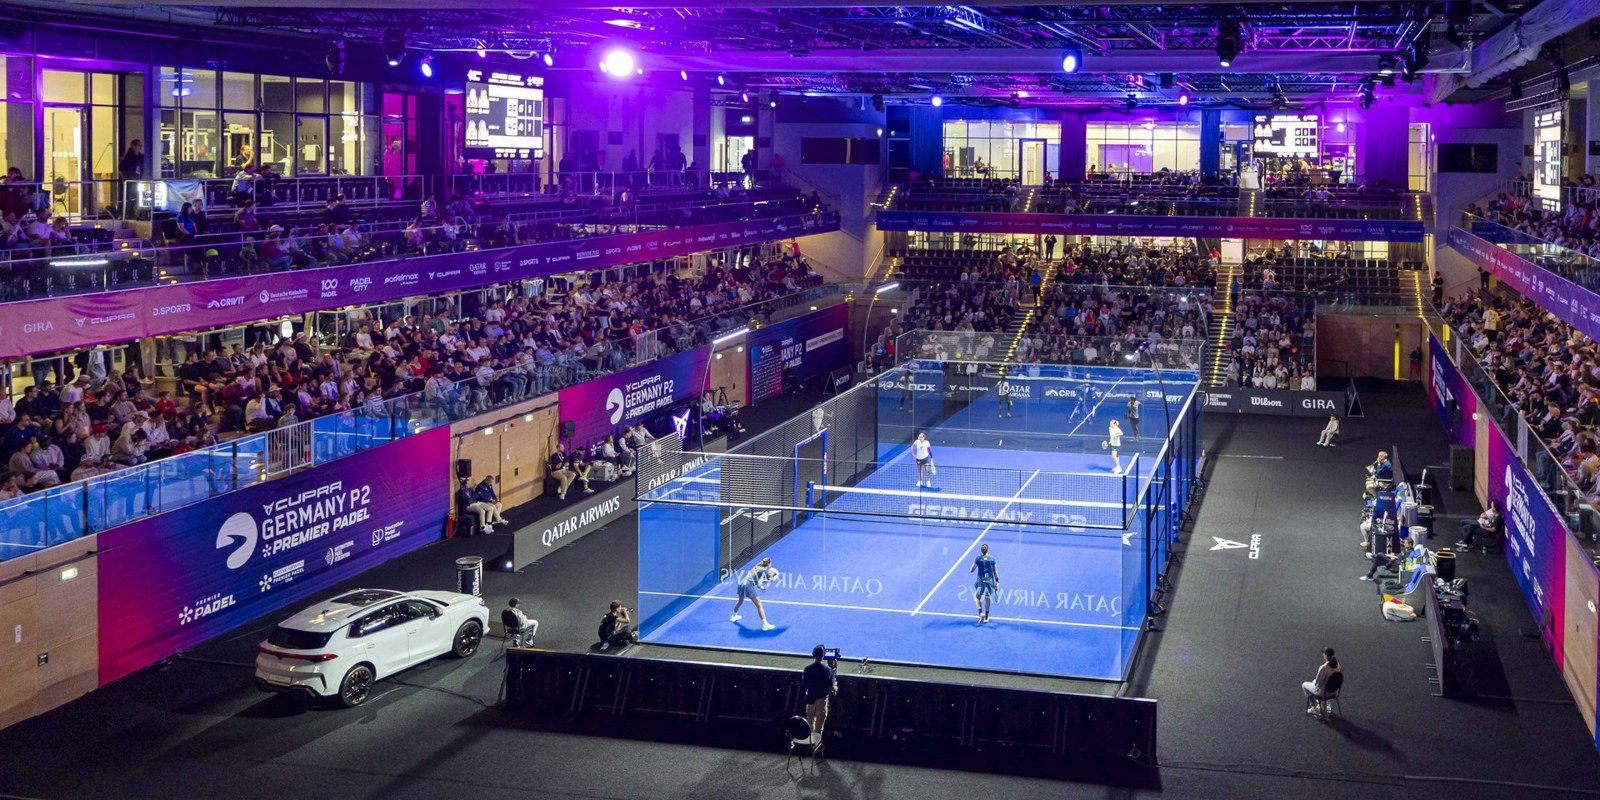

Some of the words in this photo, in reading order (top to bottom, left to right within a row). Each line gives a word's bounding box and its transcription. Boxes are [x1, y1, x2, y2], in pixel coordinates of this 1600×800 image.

[436, 270, 461, 278] CUPRA
[469, 262, 487, 272] QATAR
[321, 278, 338, 291] 100
[350, 277, 373, 287] PADEL
[354, 284, 369, 292] CITY
[220, 296, 246, 307] CRIVIT
[321, 290, 338, 298] PADEL
[90, 312, 136, 325] CUPRA
[23, 321, 54, 334] GIRA
[632, 374, 661, 389] CUPRA
[1002, 384, 1031, 393] QATAR
[625, 384, 662, 409] GERMANY
[663, 379, 674, 394] P2
[1250, 396, 1283, 407] Wilson
[629, 401, 656, 419] PREMIER
[656, 395, 674, 408] PADEL
[1302, 398, 1336, 410] GIRA
[648, 469, 676, 490] QATAR
[275, 480, 342, 511] CUPRA
[261, 491, 347, 541] GERMANY
[350, 484, 371, 509] P2
[907, 503, 1033, 528] GERMANY
[541, 515, 578, 547] QATAR
[578, 495, 620, 529] AIRWAYS
[272, 521, 330, 555] PREMIER
[333, 507, 370, 532] PADEL
[1248, 534, 1262, 559] CUPRA
[273, 572, 291, 584] PREMIER
[291, 567, 304, 576] PADEL
[472, 569, 482, 597] Wilson
[195, 592, 221, 607] PREMIER
[193, 594, 237, 621] PADEL
